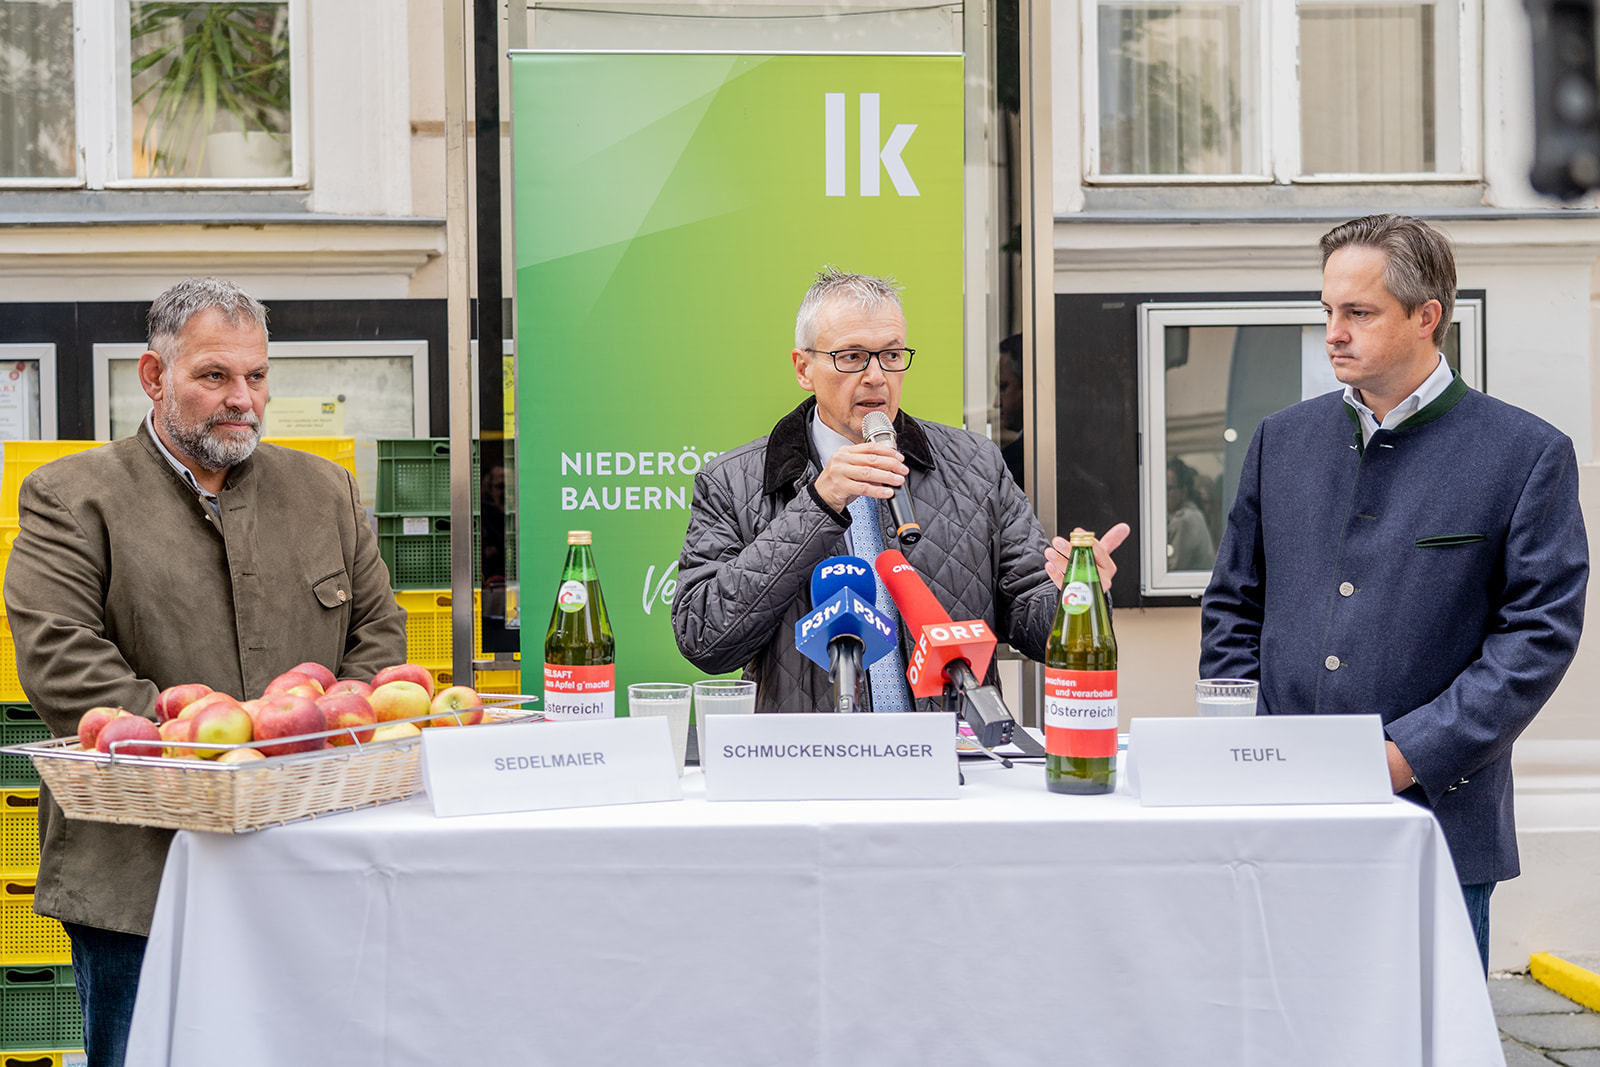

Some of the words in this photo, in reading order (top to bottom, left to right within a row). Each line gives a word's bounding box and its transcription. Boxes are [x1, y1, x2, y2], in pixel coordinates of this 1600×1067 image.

[930, 623, 985, 641] ORF
[910, 634, 928, 685] ORF
[555, 680, 575, 690] Apfel
[1055, 689, 1070, 697] und
[545, 701, 604, 715] sterreich!
[723, 743, 934, 760] SCHMUCKENSCHLAGER
[1230, 748, 1287, 763] TEUFL
[494, 751, 607, 773] SEDELMAIER
